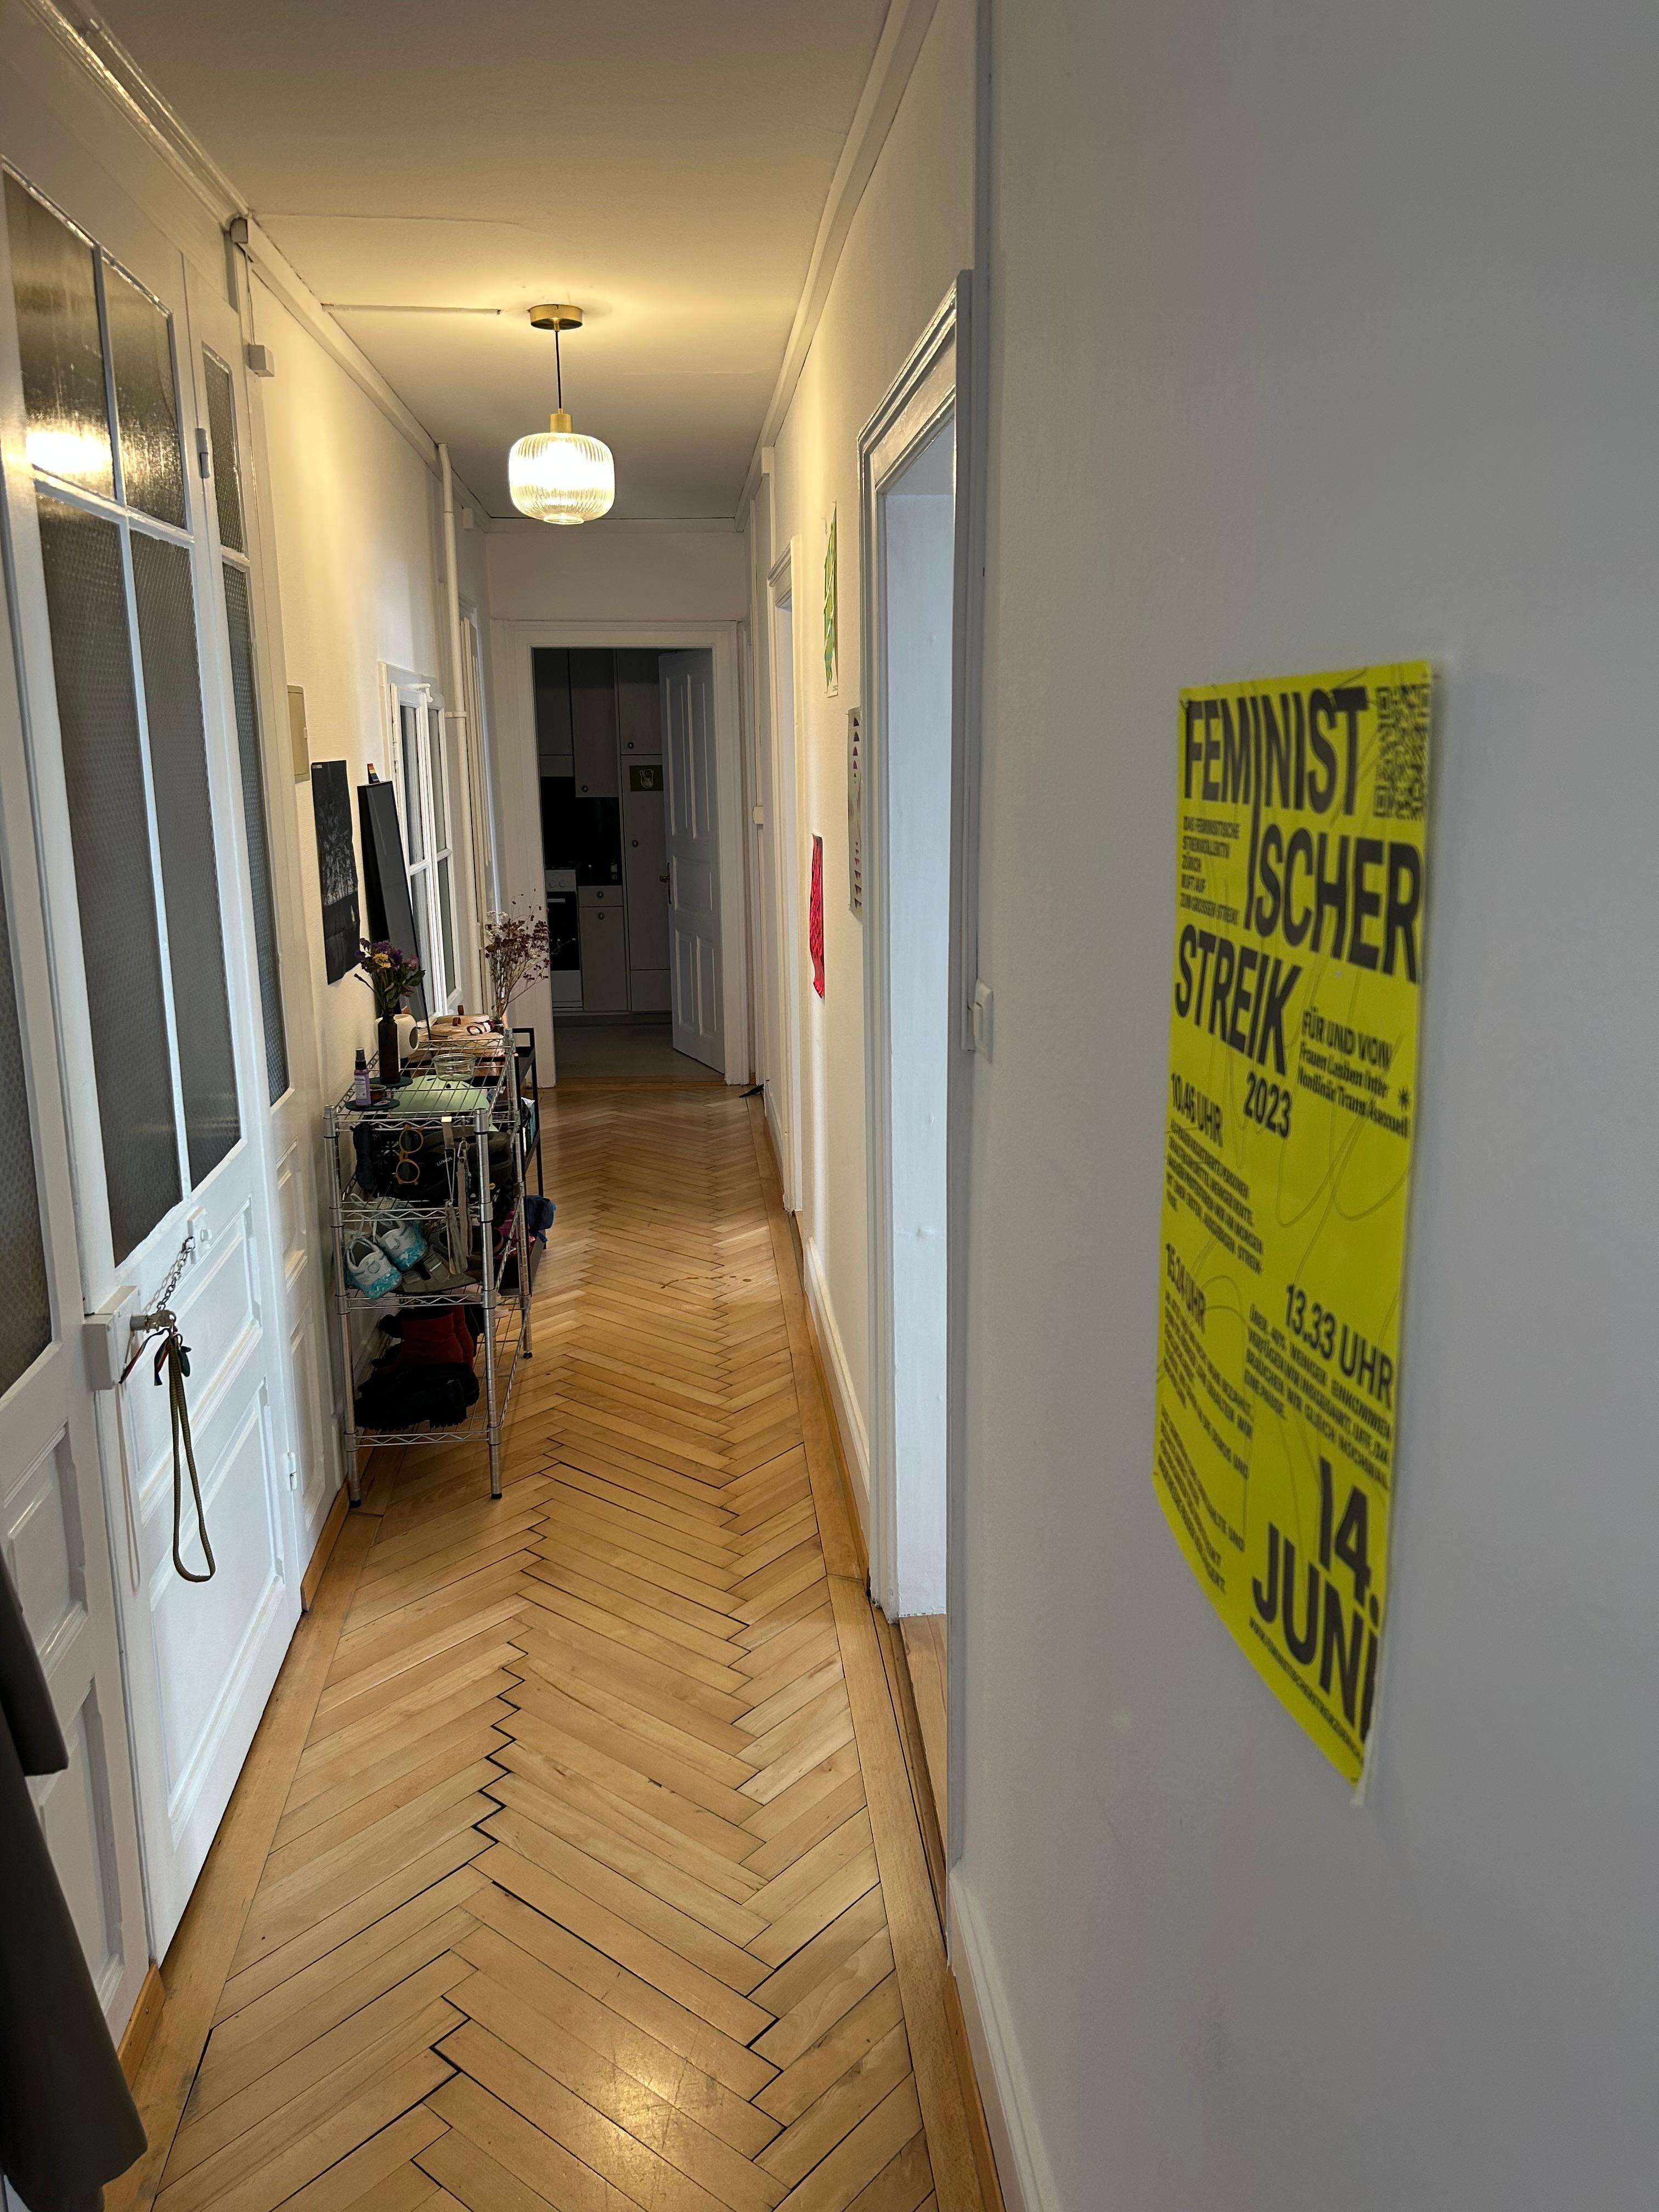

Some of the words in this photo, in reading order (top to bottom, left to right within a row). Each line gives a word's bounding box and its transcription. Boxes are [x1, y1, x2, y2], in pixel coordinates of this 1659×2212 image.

[1183, 687, 1369, 816] FEMINIST
[1243, 823, 1420, 983] ISCHER
[1175, 924, 1302, 1076] STREIK
[1300, 1041, 1327, 1071] Frauen
[1302, 1006, 1325, 1043] FÜR
[1326, 1021, 1356, 1056] UND
[1358, 1032, 1392, 1073] VON
[1197, 1086, 1223, 1148] UHR
[1243, 1071, 1293, 1138] 2023
[1186, 1277, 1206, 1334] UHR
[1286, 1283, 1336, 1361] 13.33
[1339, 1323, 1393, 1412] UHR
[1318, 1454, 1379, 1629] 14.
[1251, 1521, 1378, 1745] JUNI
